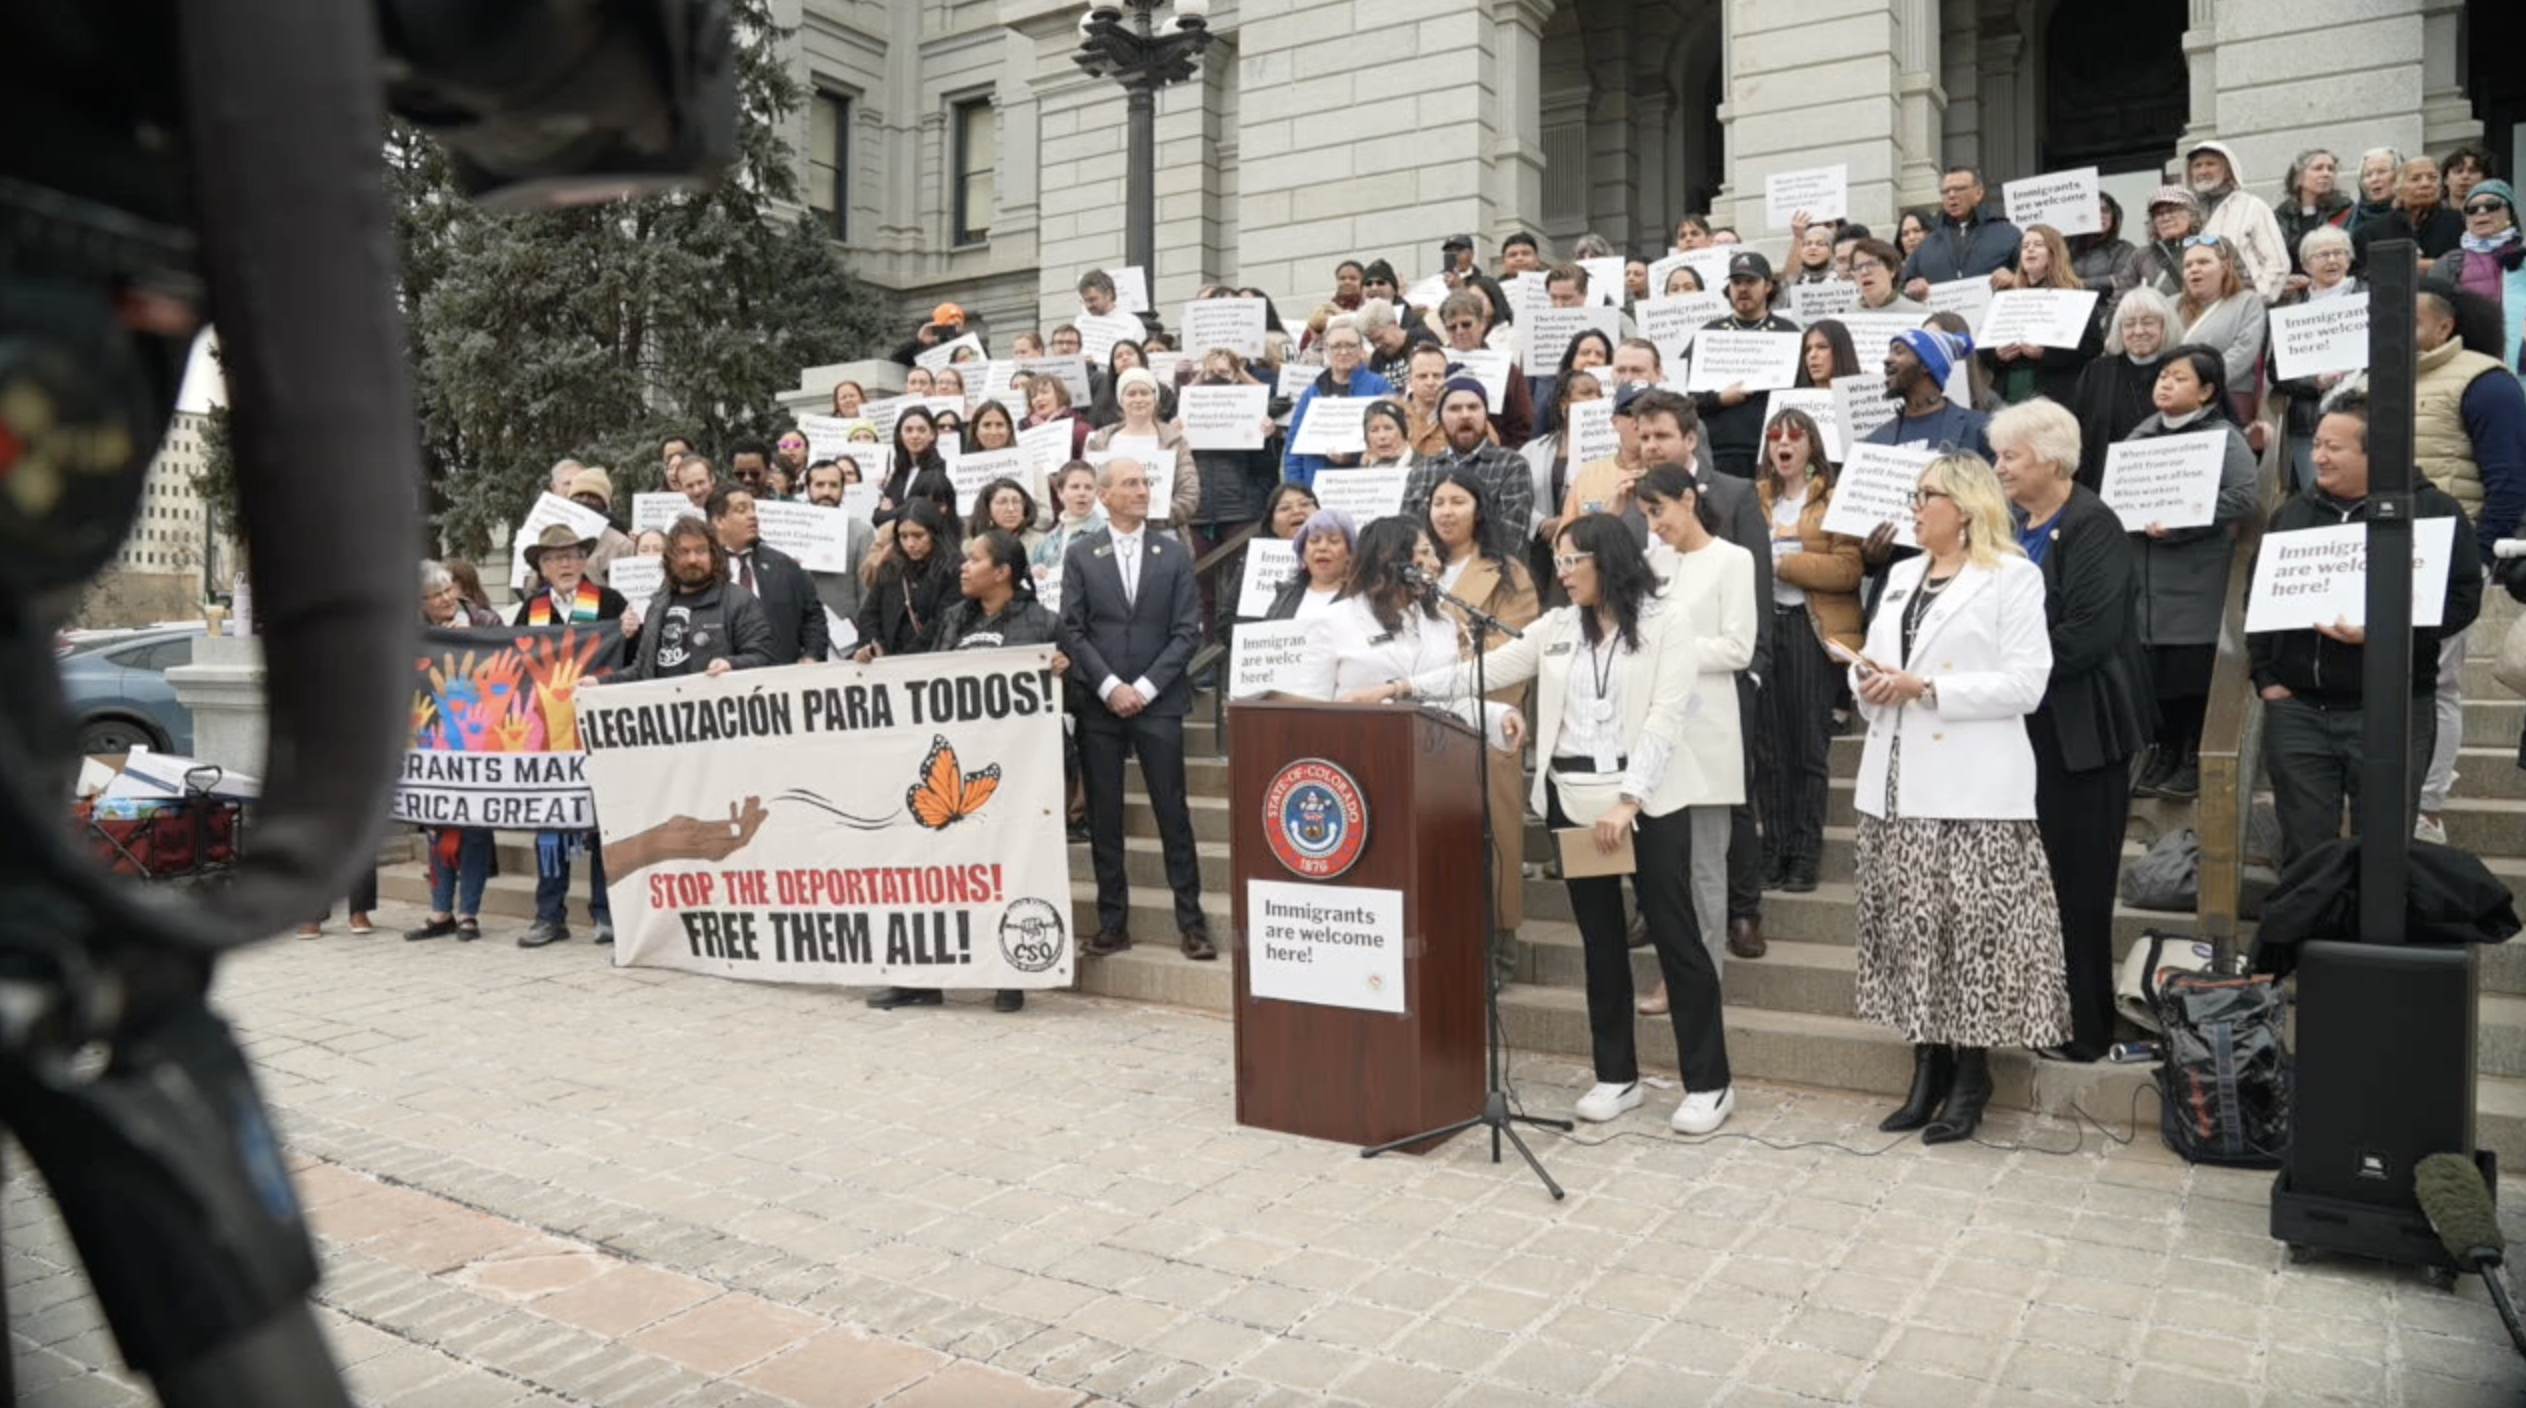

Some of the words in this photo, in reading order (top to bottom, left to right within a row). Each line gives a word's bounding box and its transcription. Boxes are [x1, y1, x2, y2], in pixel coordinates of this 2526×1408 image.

[2013, 181, 2081, 200] Immigrants
[2015, 202, 2031, 212] are
[2034, 193, 2087, 207] welcome
[2015, 209, 2043, 223] here!
[1647, 301, 1717, 318] Immigrants
[1649, 320, 1667, 330] are
[1650, 329, 1679, 341] here!
[2287, 331, 2313, 342] are
[2288, 339, 2330, 356] here!
[1848, 382, 1879, 393] When
[1861, 452, 1891, 462] When
[2120, 449, 2147, 459] When
[956, 458, 1019, 474] Immigrants
[1855, 466, 1885, 477] profit
[956, 476, 974, 485] are
[1847, 490, 1877, 501] When
[2113, 489, 2140, 498] When
[1258, 568, 1284, 579] are
[2274, 565, 2311, 578] are
[2271, 578, 2331, 597] here!
[1241, 655, 1262, 667] are
[1241, 668, 1275, 685] here!
[579, 686, 793, 755] ¡LEGALIZACIÓN
[803, 682, 895, 733] PARA
[904, 669, 1055, 725] TODOS!
[402, 753, 501, 783] RANTS
[1267, 780, 1289, 818] STATE
[1288, 767, 1302, 781] OF
[1307, 765, 1359, 823] COLORADO
[484, 796, 587, 824] GREAT
[1301, 858, 1329, 872] 1876
[649, 872, 715, 909] STOP
[721, 868, 771, 906] THE
[776, 864, 1003, 906] DEPORTATIONS!
[1265, 899, 1375, 924] Immigrants
[680, 911, 760, 961] FREE
[768, 911, 873, 964] THEM
[886, 911, 972, 965] ALL!
[1265, 924, 1295, 940] are
[1299, 926, 1384, 948] welcome
[1266, 943, 1313, 963] here!
